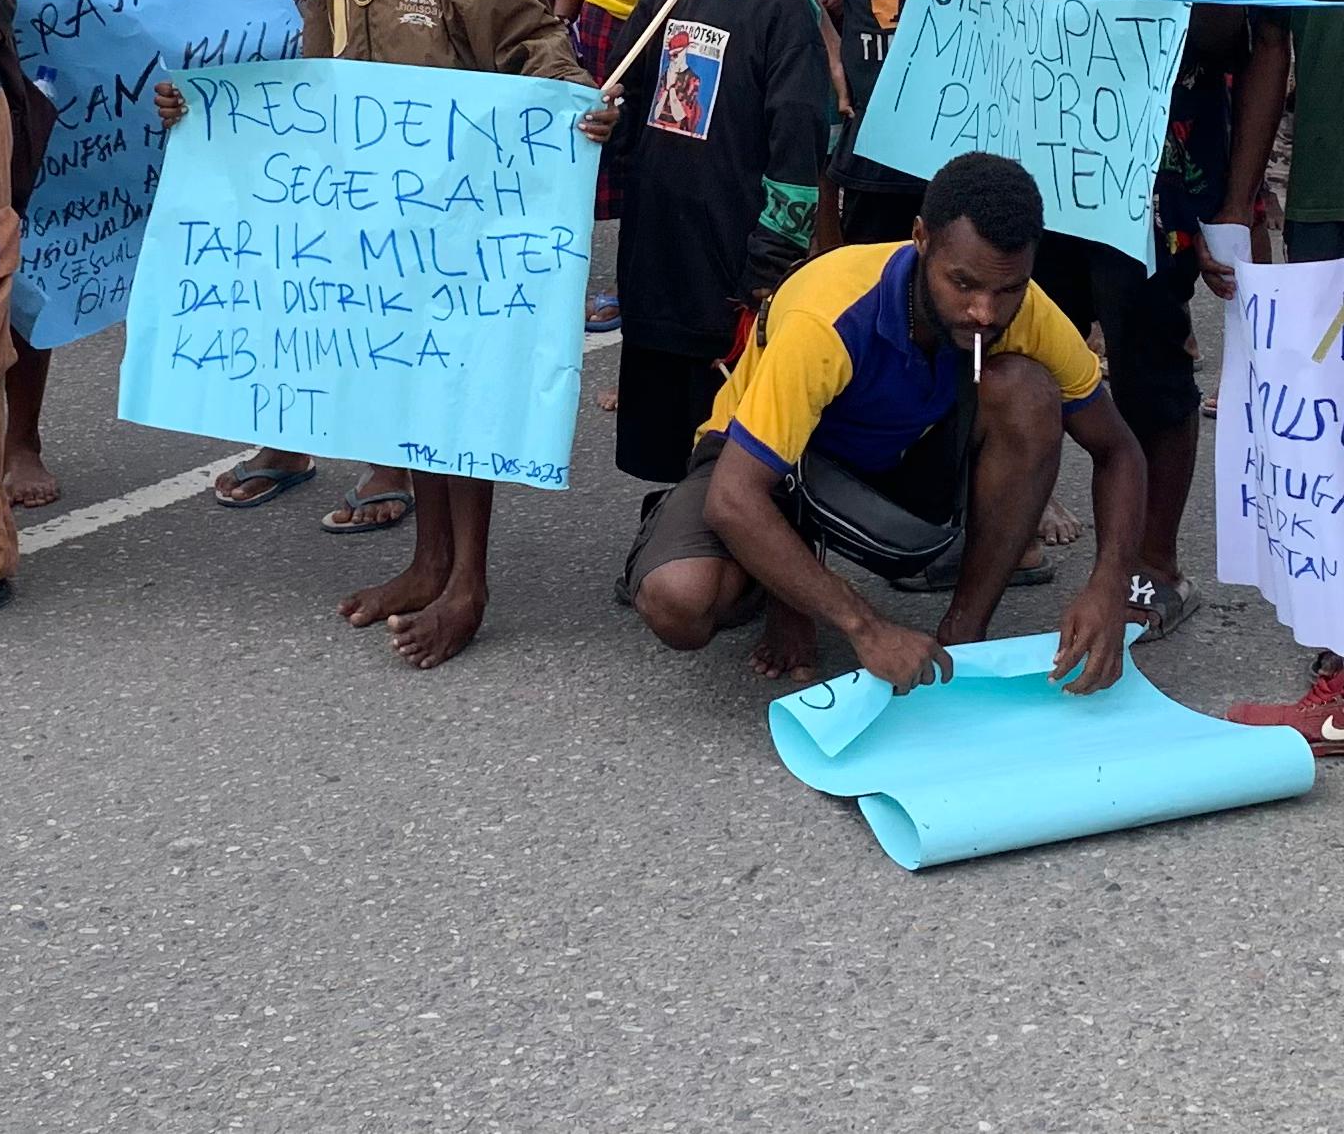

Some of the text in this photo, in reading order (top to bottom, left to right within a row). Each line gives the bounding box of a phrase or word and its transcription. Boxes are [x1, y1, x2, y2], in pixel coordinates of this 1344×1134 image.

[860, 33, 895, 61] TI
[252, 152, 527, 217] SEGERAH
[1036, 141, 1153, 227] TENG
[178, 219, 589, 283] TARIK MILITER
[172, 275, 537, 321] DARI DISTRIK JILA
[250, 383, 330, 438] PPT.
